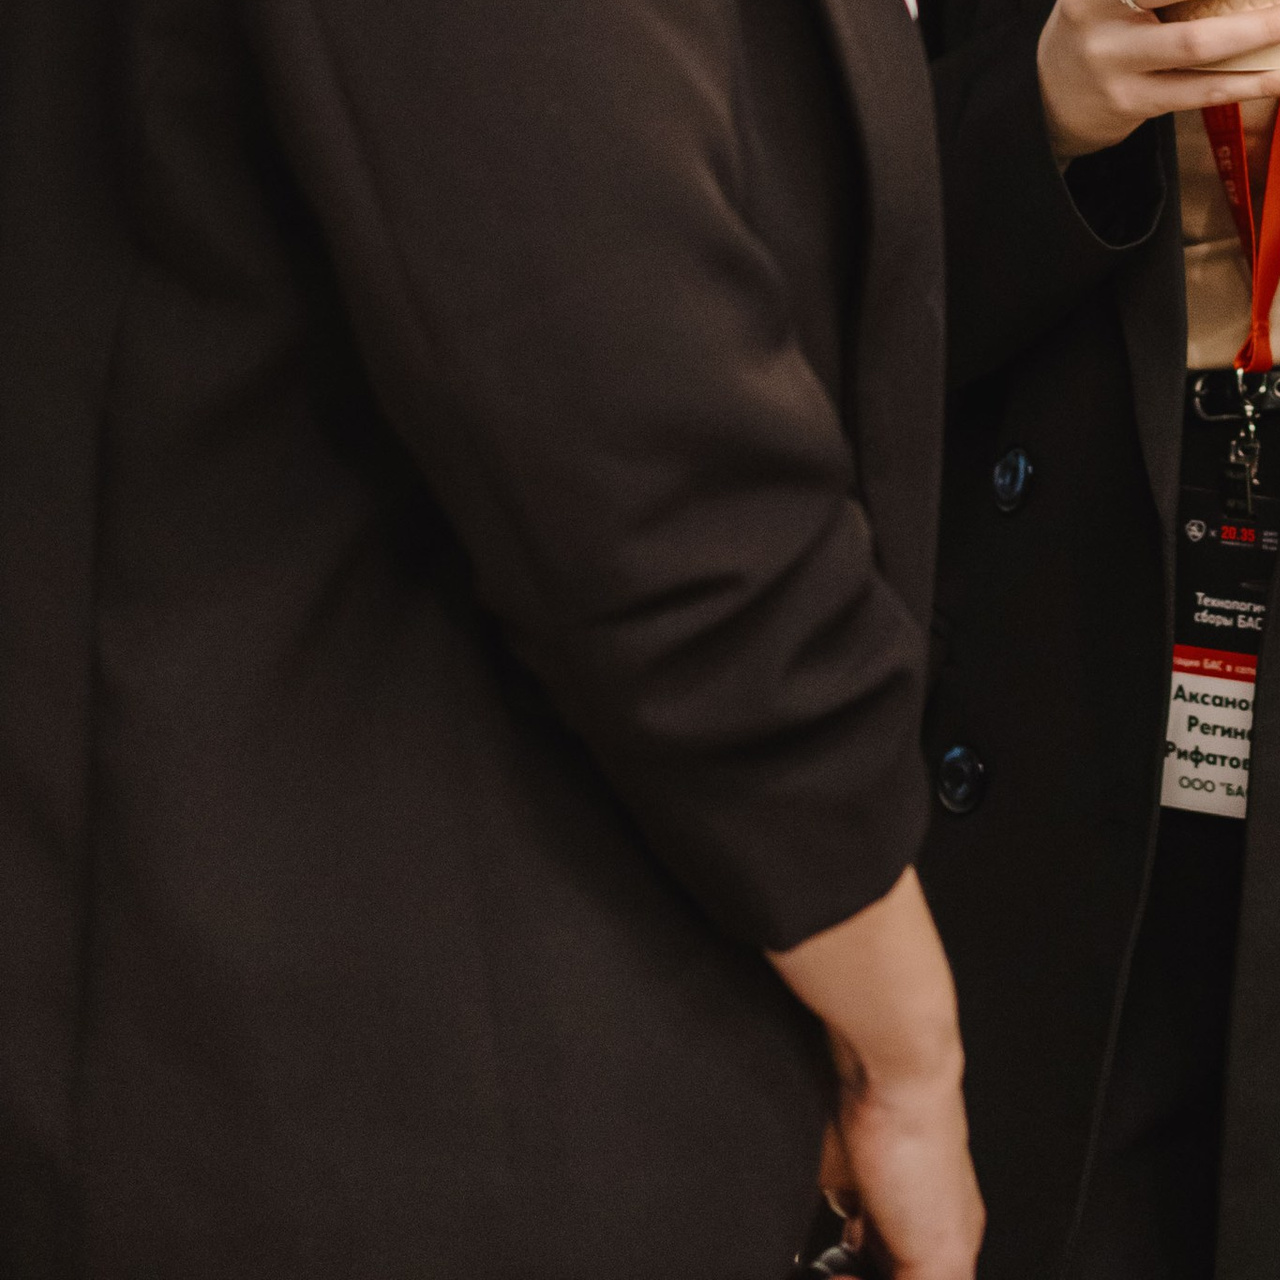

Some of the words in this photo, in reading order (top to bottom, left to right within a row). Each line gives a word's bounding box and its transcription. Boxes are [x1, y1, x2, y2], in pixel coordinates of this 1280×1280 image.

[1220, 525, 1256, 543] 20.35
[1237, 614, 1263, 630] БАС
[1174, 684, 1253, 712] Аксано
[1179, 776, 1215, 792] ООО
[1220, 781, 1248, 798] "БА
